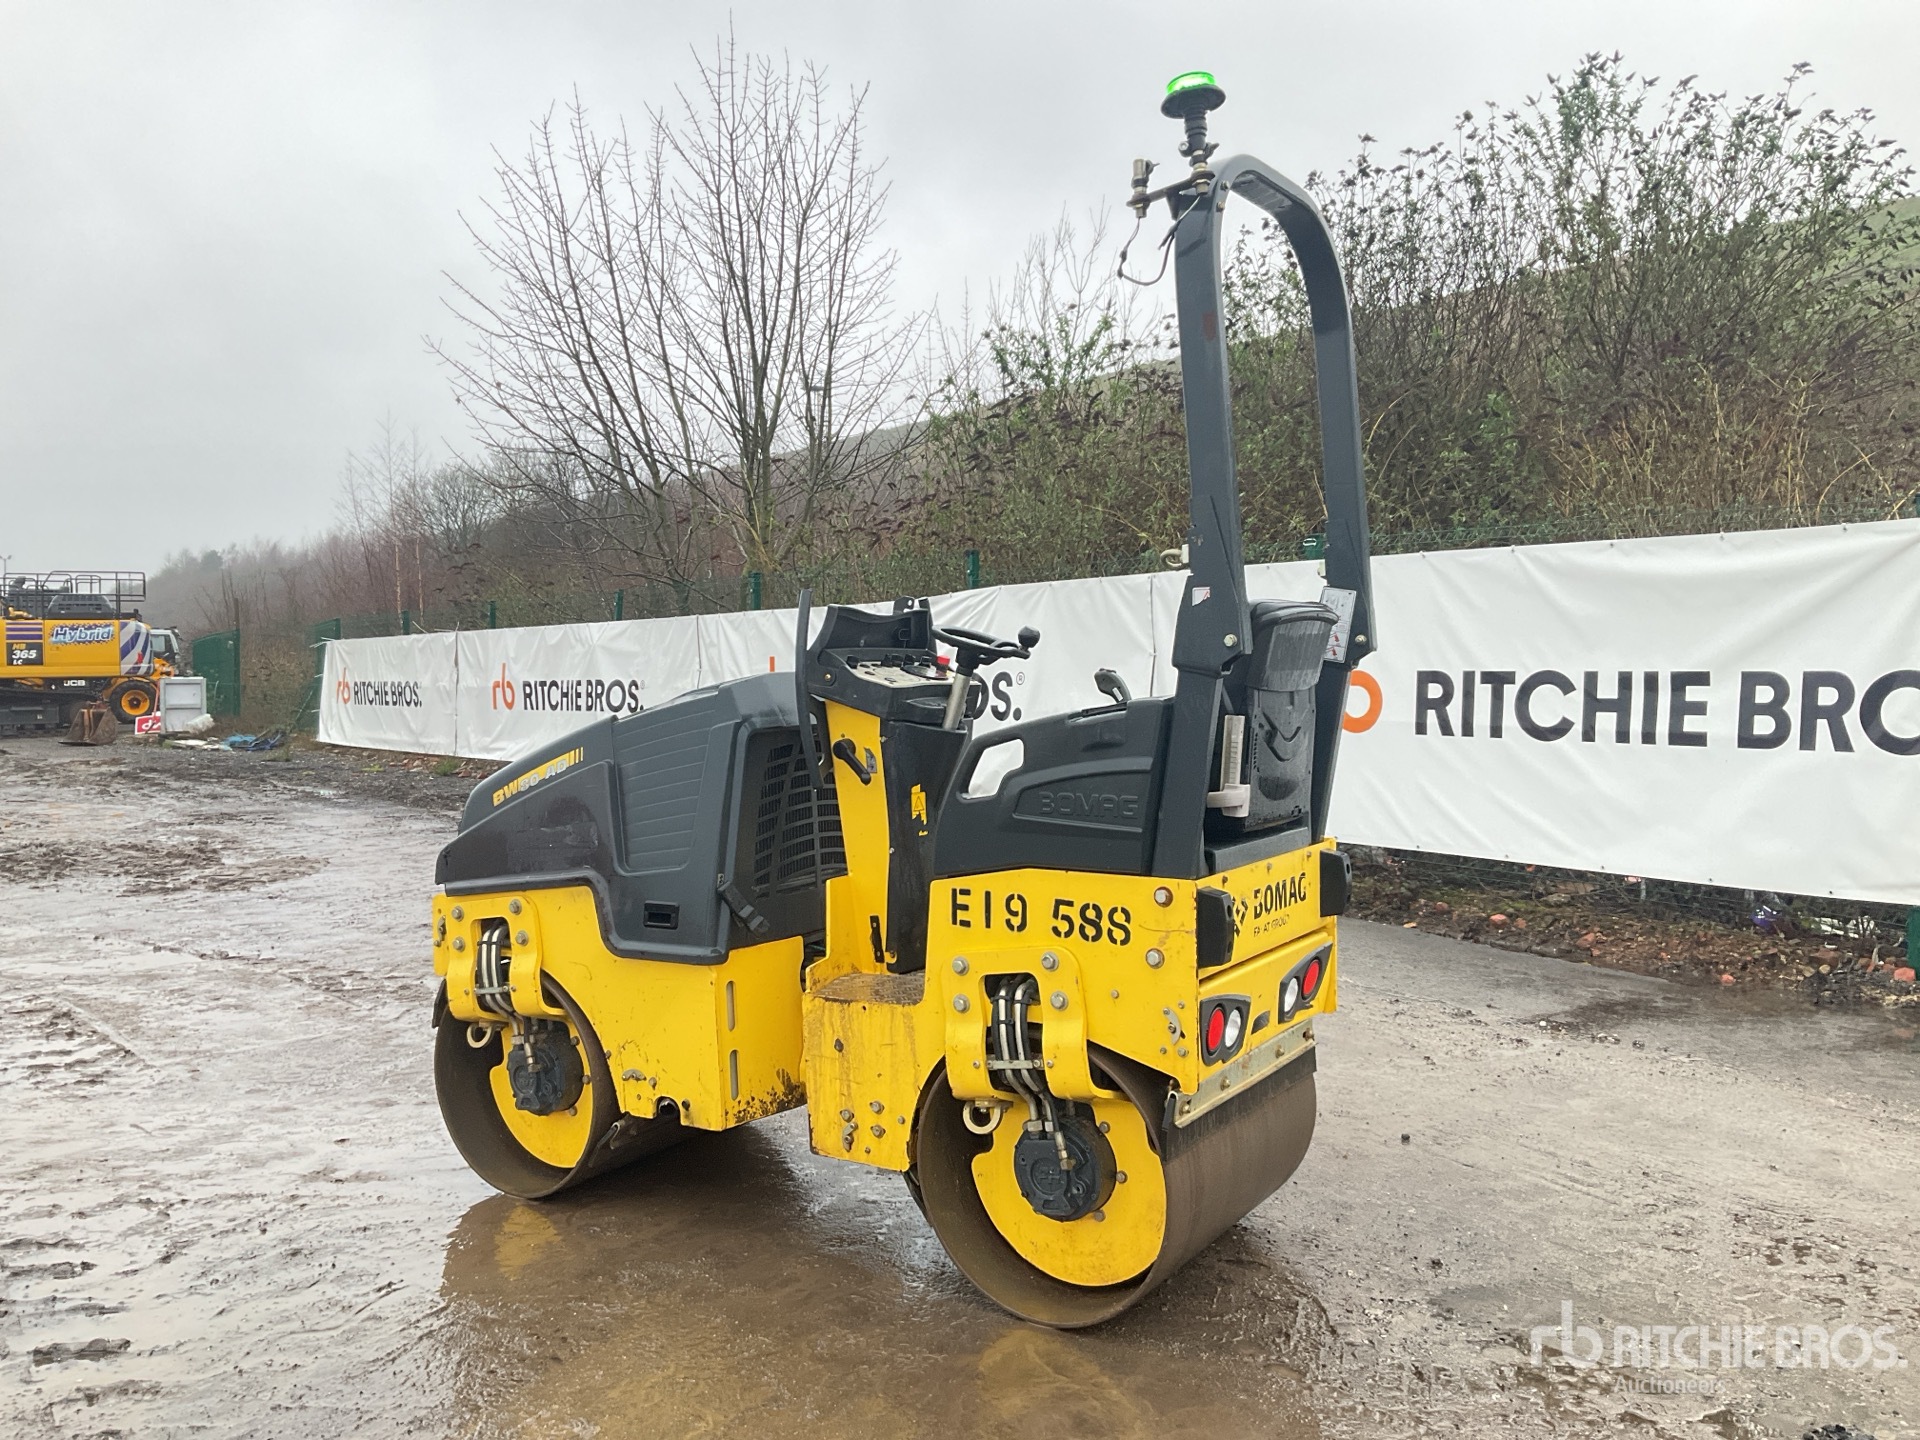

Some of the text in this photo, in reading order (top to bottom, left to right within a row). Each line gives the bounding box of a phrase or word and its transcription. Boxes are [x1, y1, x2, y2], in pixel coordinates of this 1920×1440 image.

[53, 627, 113, 642] Hybrid
[12, 650, 37, 659] 365
[353, 681, 390, 706] RITCHIE
[390, 681, 422, 708] BROS.
[522, 680, 582, 711] RITCHIE
[1414, 669, 1711, 748] RITCHIE
[1051, 898, 1132, 947] 588
